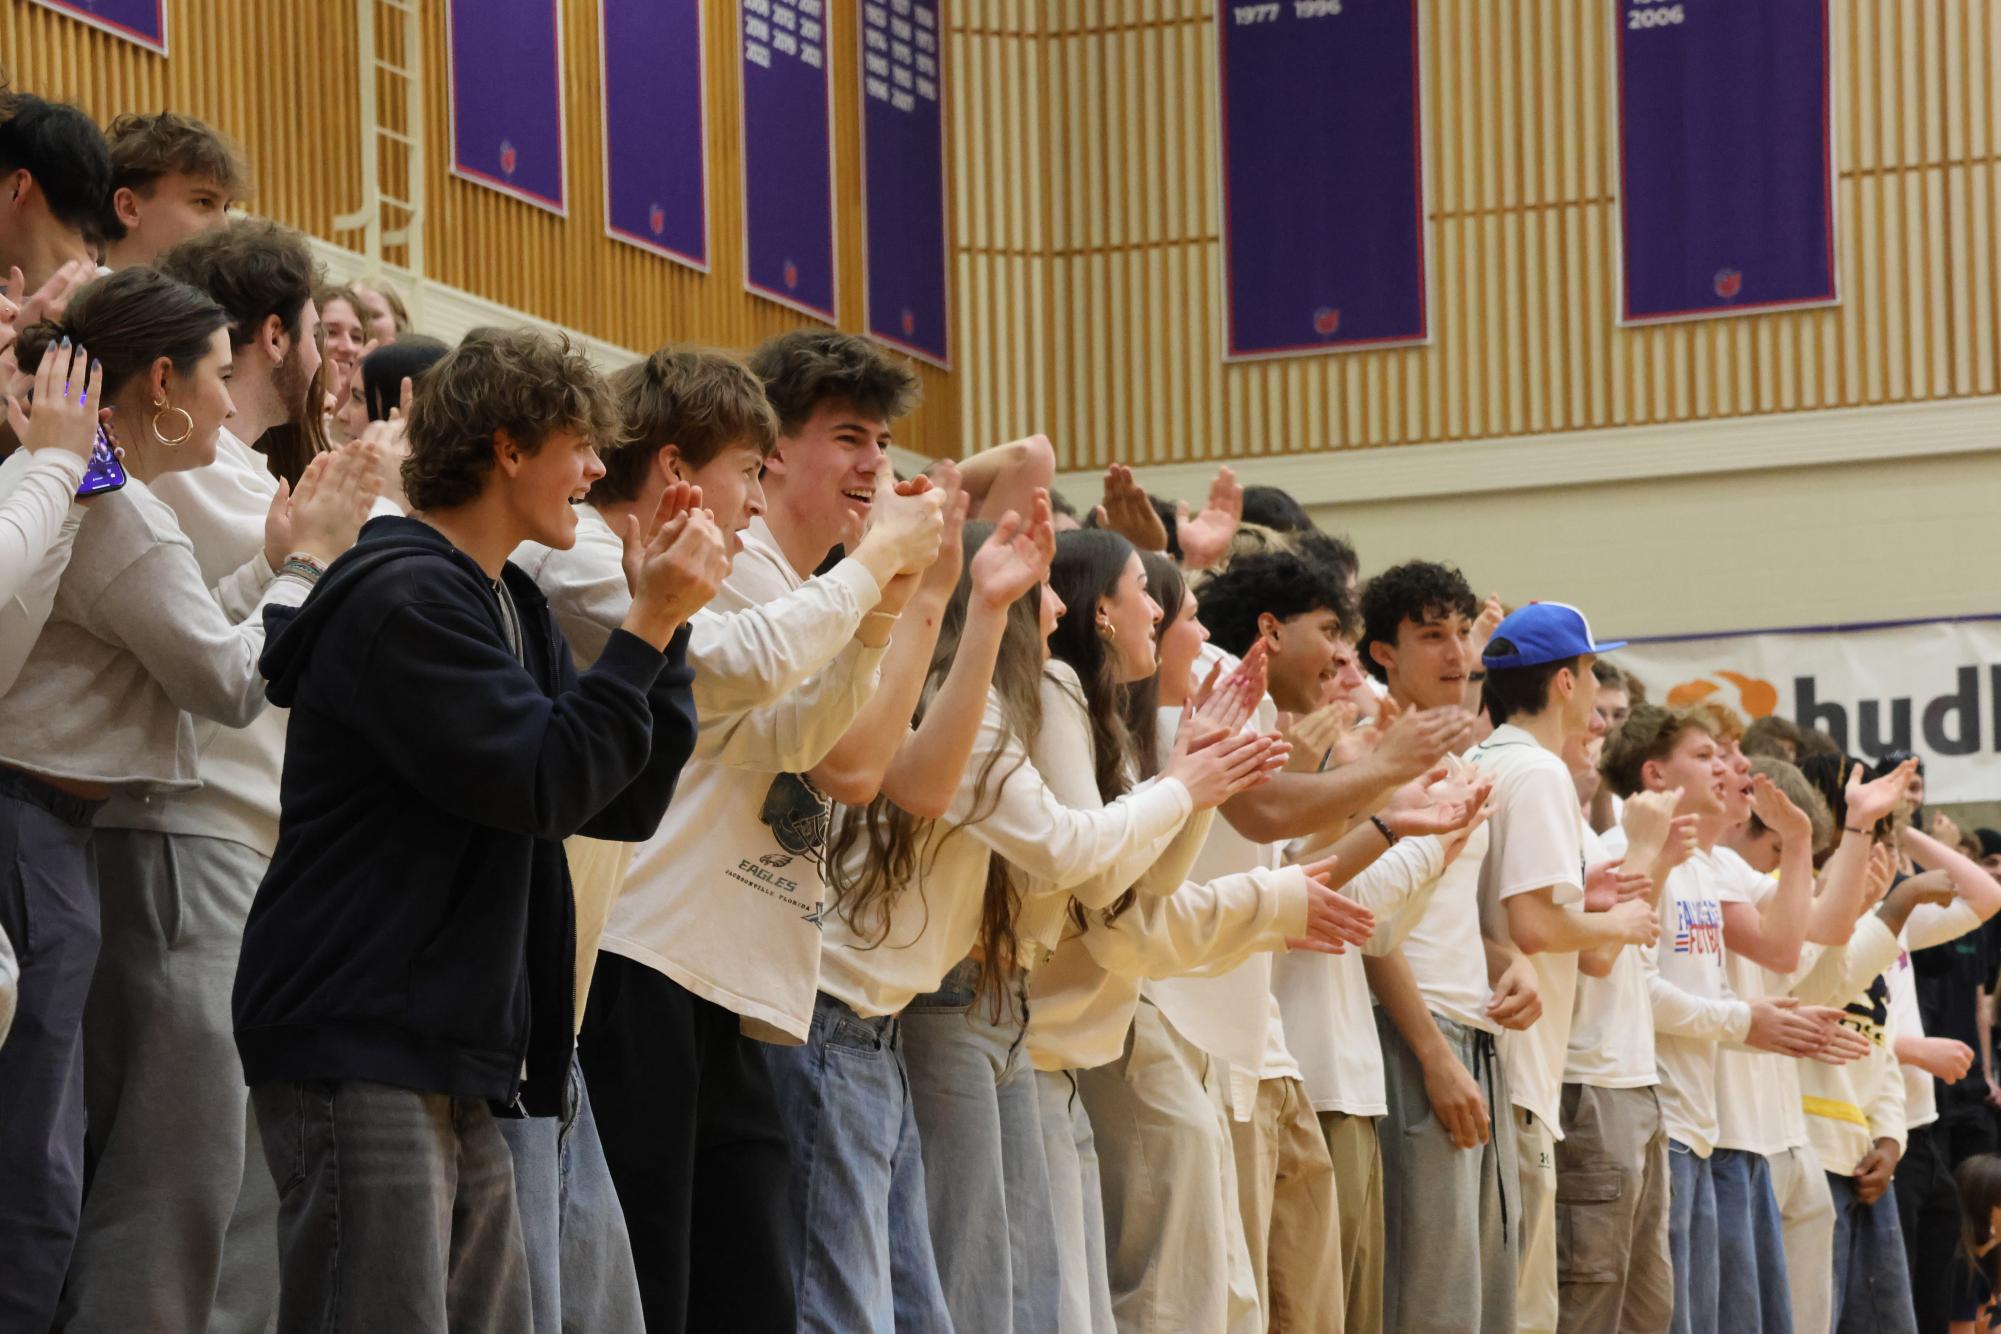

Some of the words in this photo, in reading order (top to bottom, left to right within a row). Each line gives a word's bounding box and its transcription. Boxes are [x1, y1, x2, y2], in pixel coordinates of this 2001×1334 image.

[1234, 4, 1280, 25] 1977
[1628, 4, 1685, 29] 2006
[725, 869, 775, 896] JACKSONVILLE
[779, 894, 810, 911] FLORIDA
[739, 859, 798, 892] EAGLES
